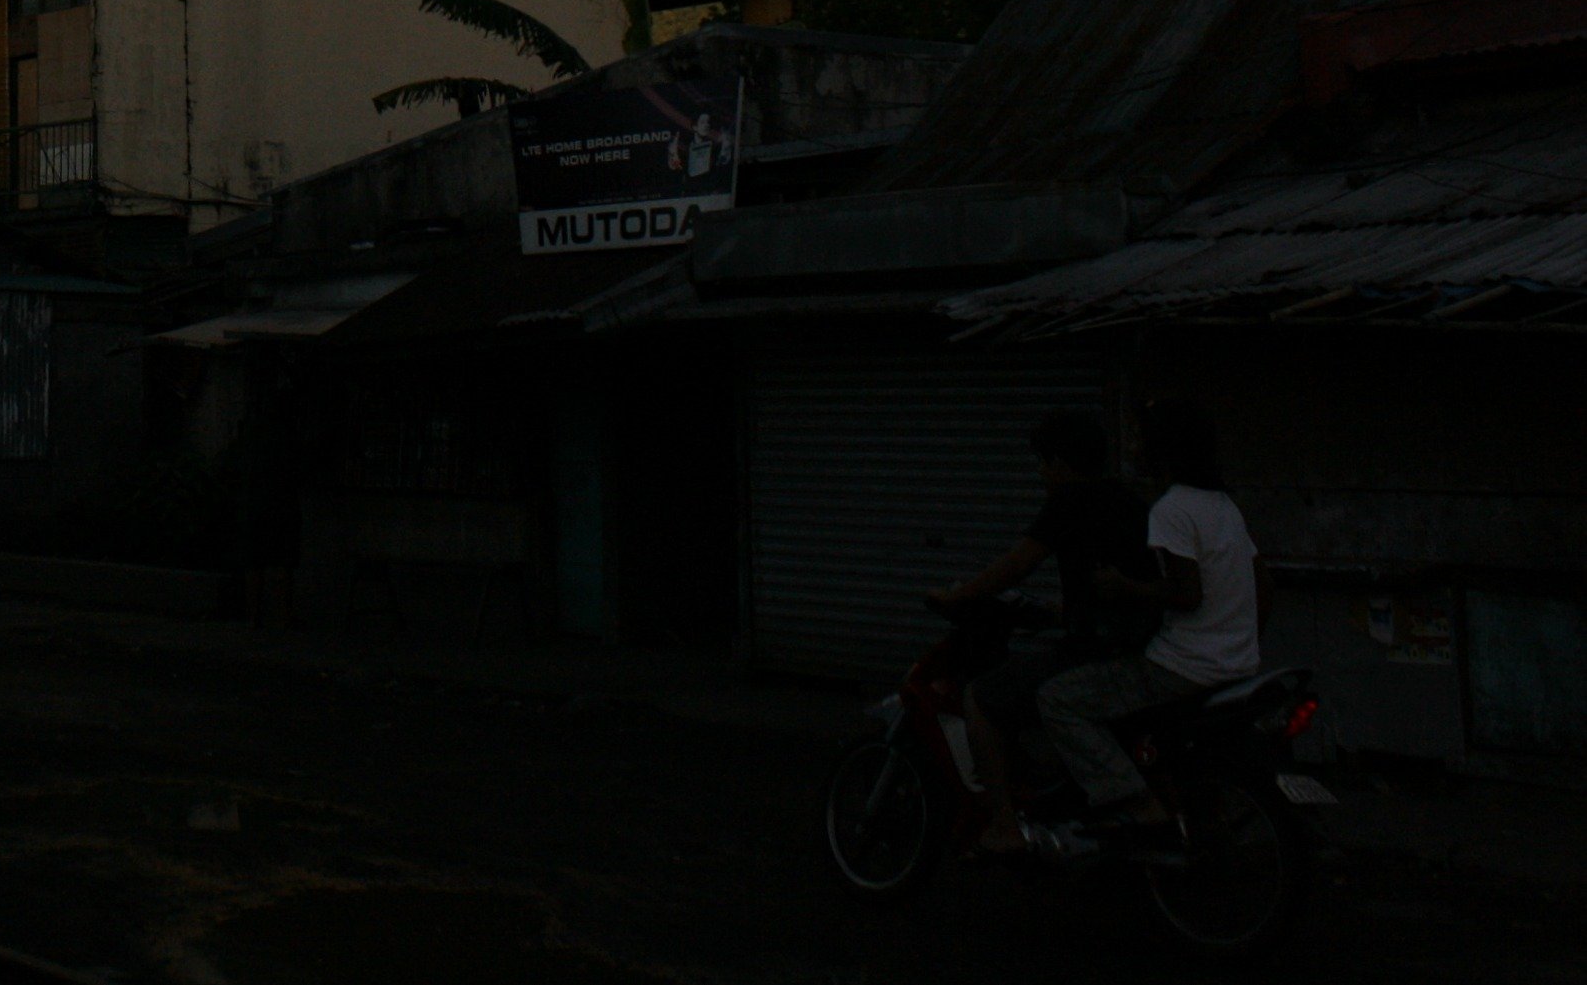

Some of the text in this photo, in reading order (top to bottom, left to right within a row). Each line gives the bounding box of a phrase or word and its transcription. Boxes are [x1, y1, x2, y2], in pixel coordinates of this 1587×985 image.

[522, 130, 672, 157] LTE HOME BROADBAND
[559, 149, 631, 167] NOW HERE
[536, 204, 701, 247] MUTODA
